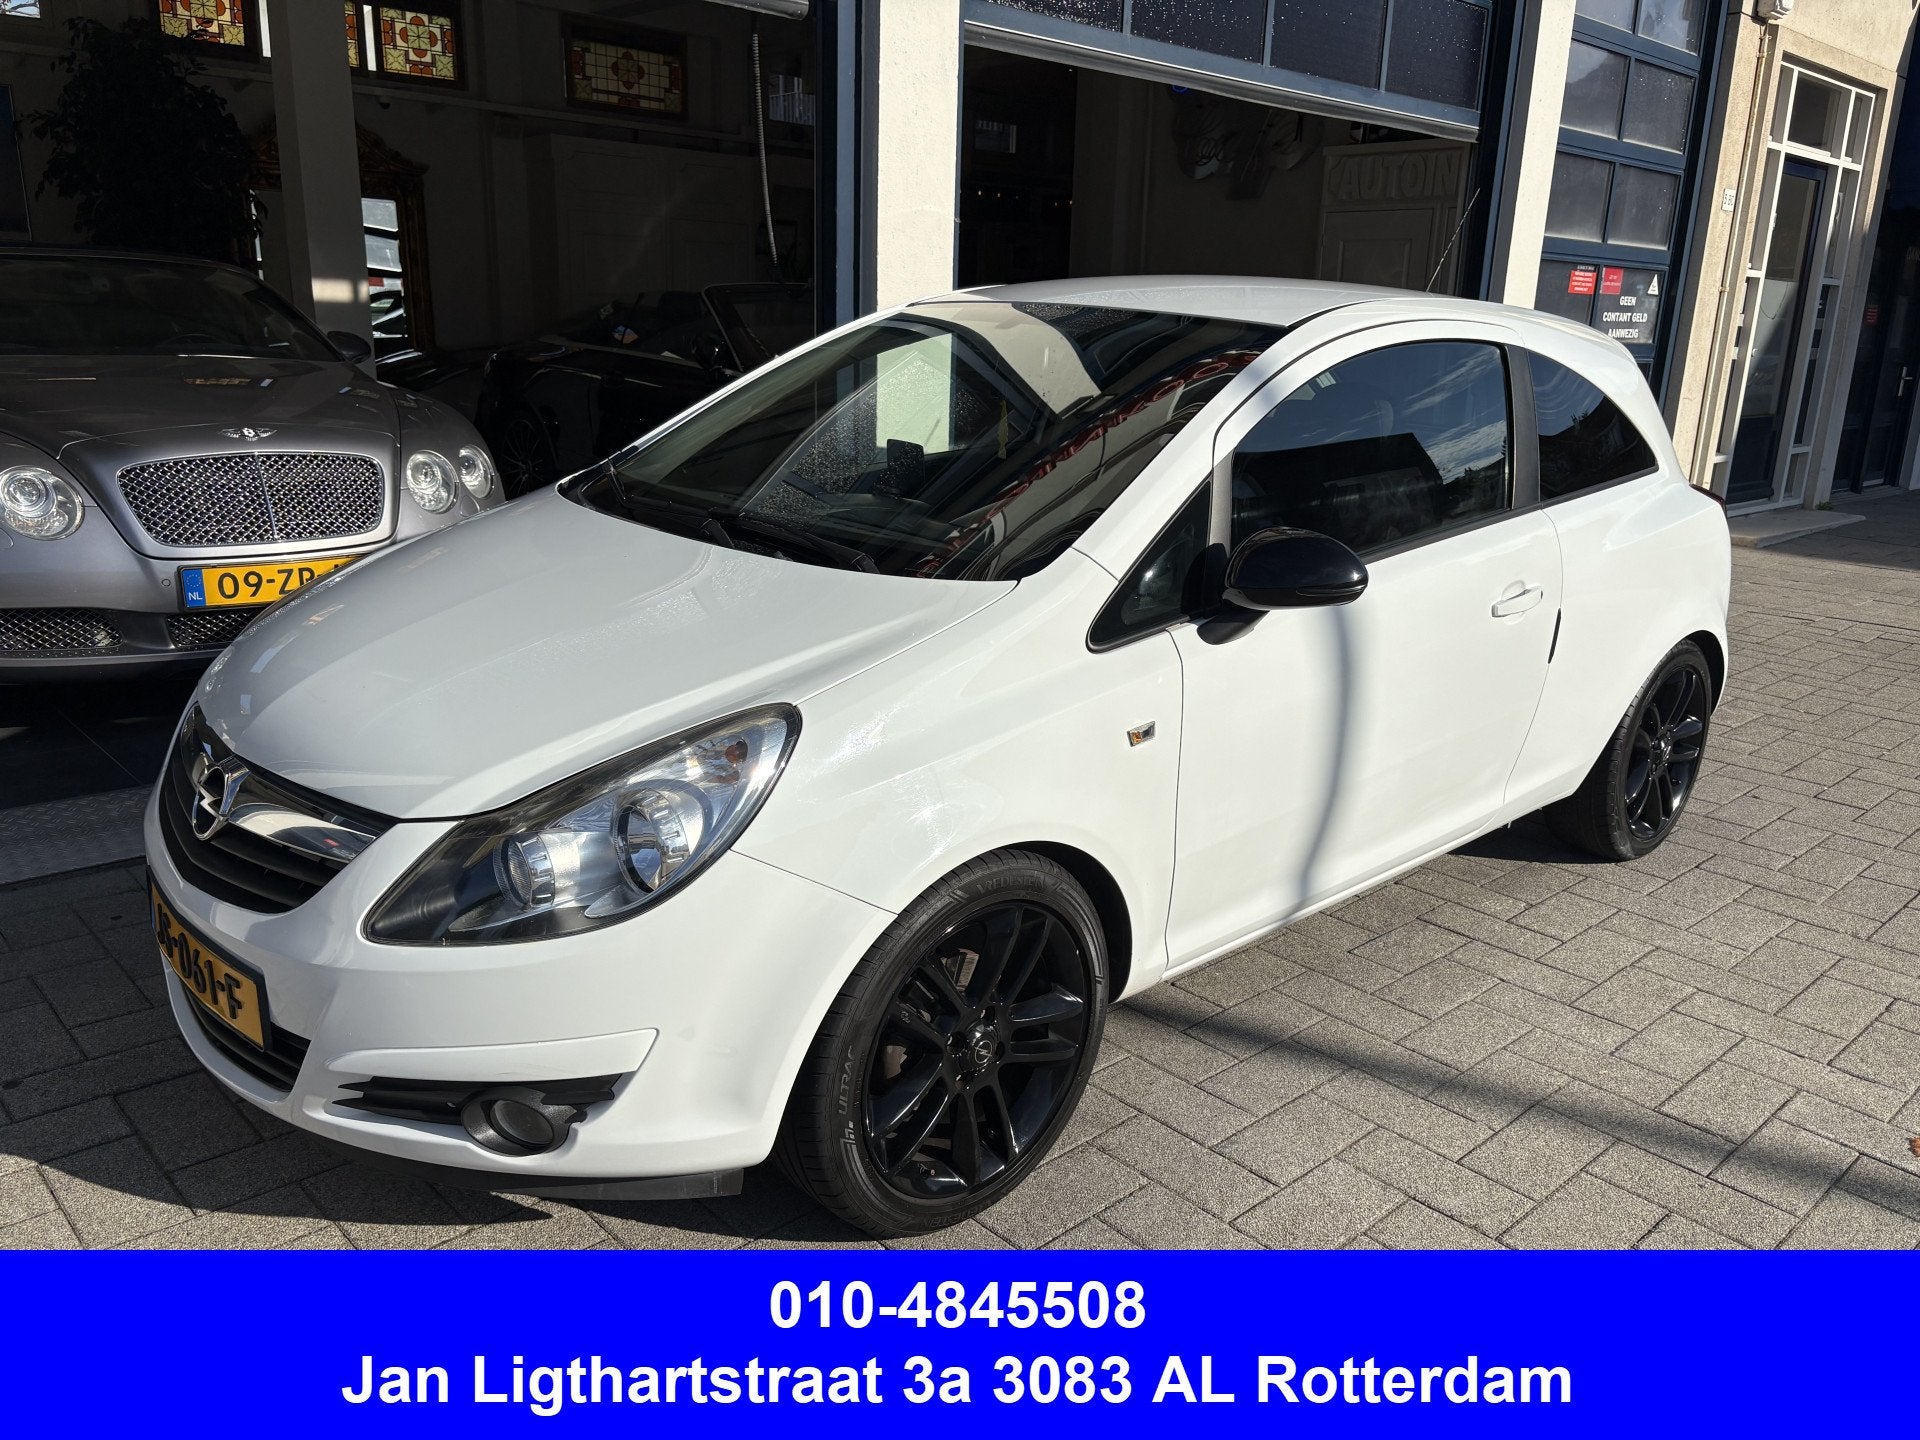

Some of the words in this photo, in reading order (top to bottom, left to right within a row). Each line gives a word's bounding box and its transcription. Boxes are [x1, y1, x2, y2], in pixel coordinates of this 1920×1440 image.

[1620, 296, 1637, 306] GEEN
[1603, 312, 1632, 322] CONTANT
[1632, 313, 1648, 323] GELD
[1608, 329, 1639, 339] AANWEZIG
[188, 591, 203, 600] NL
